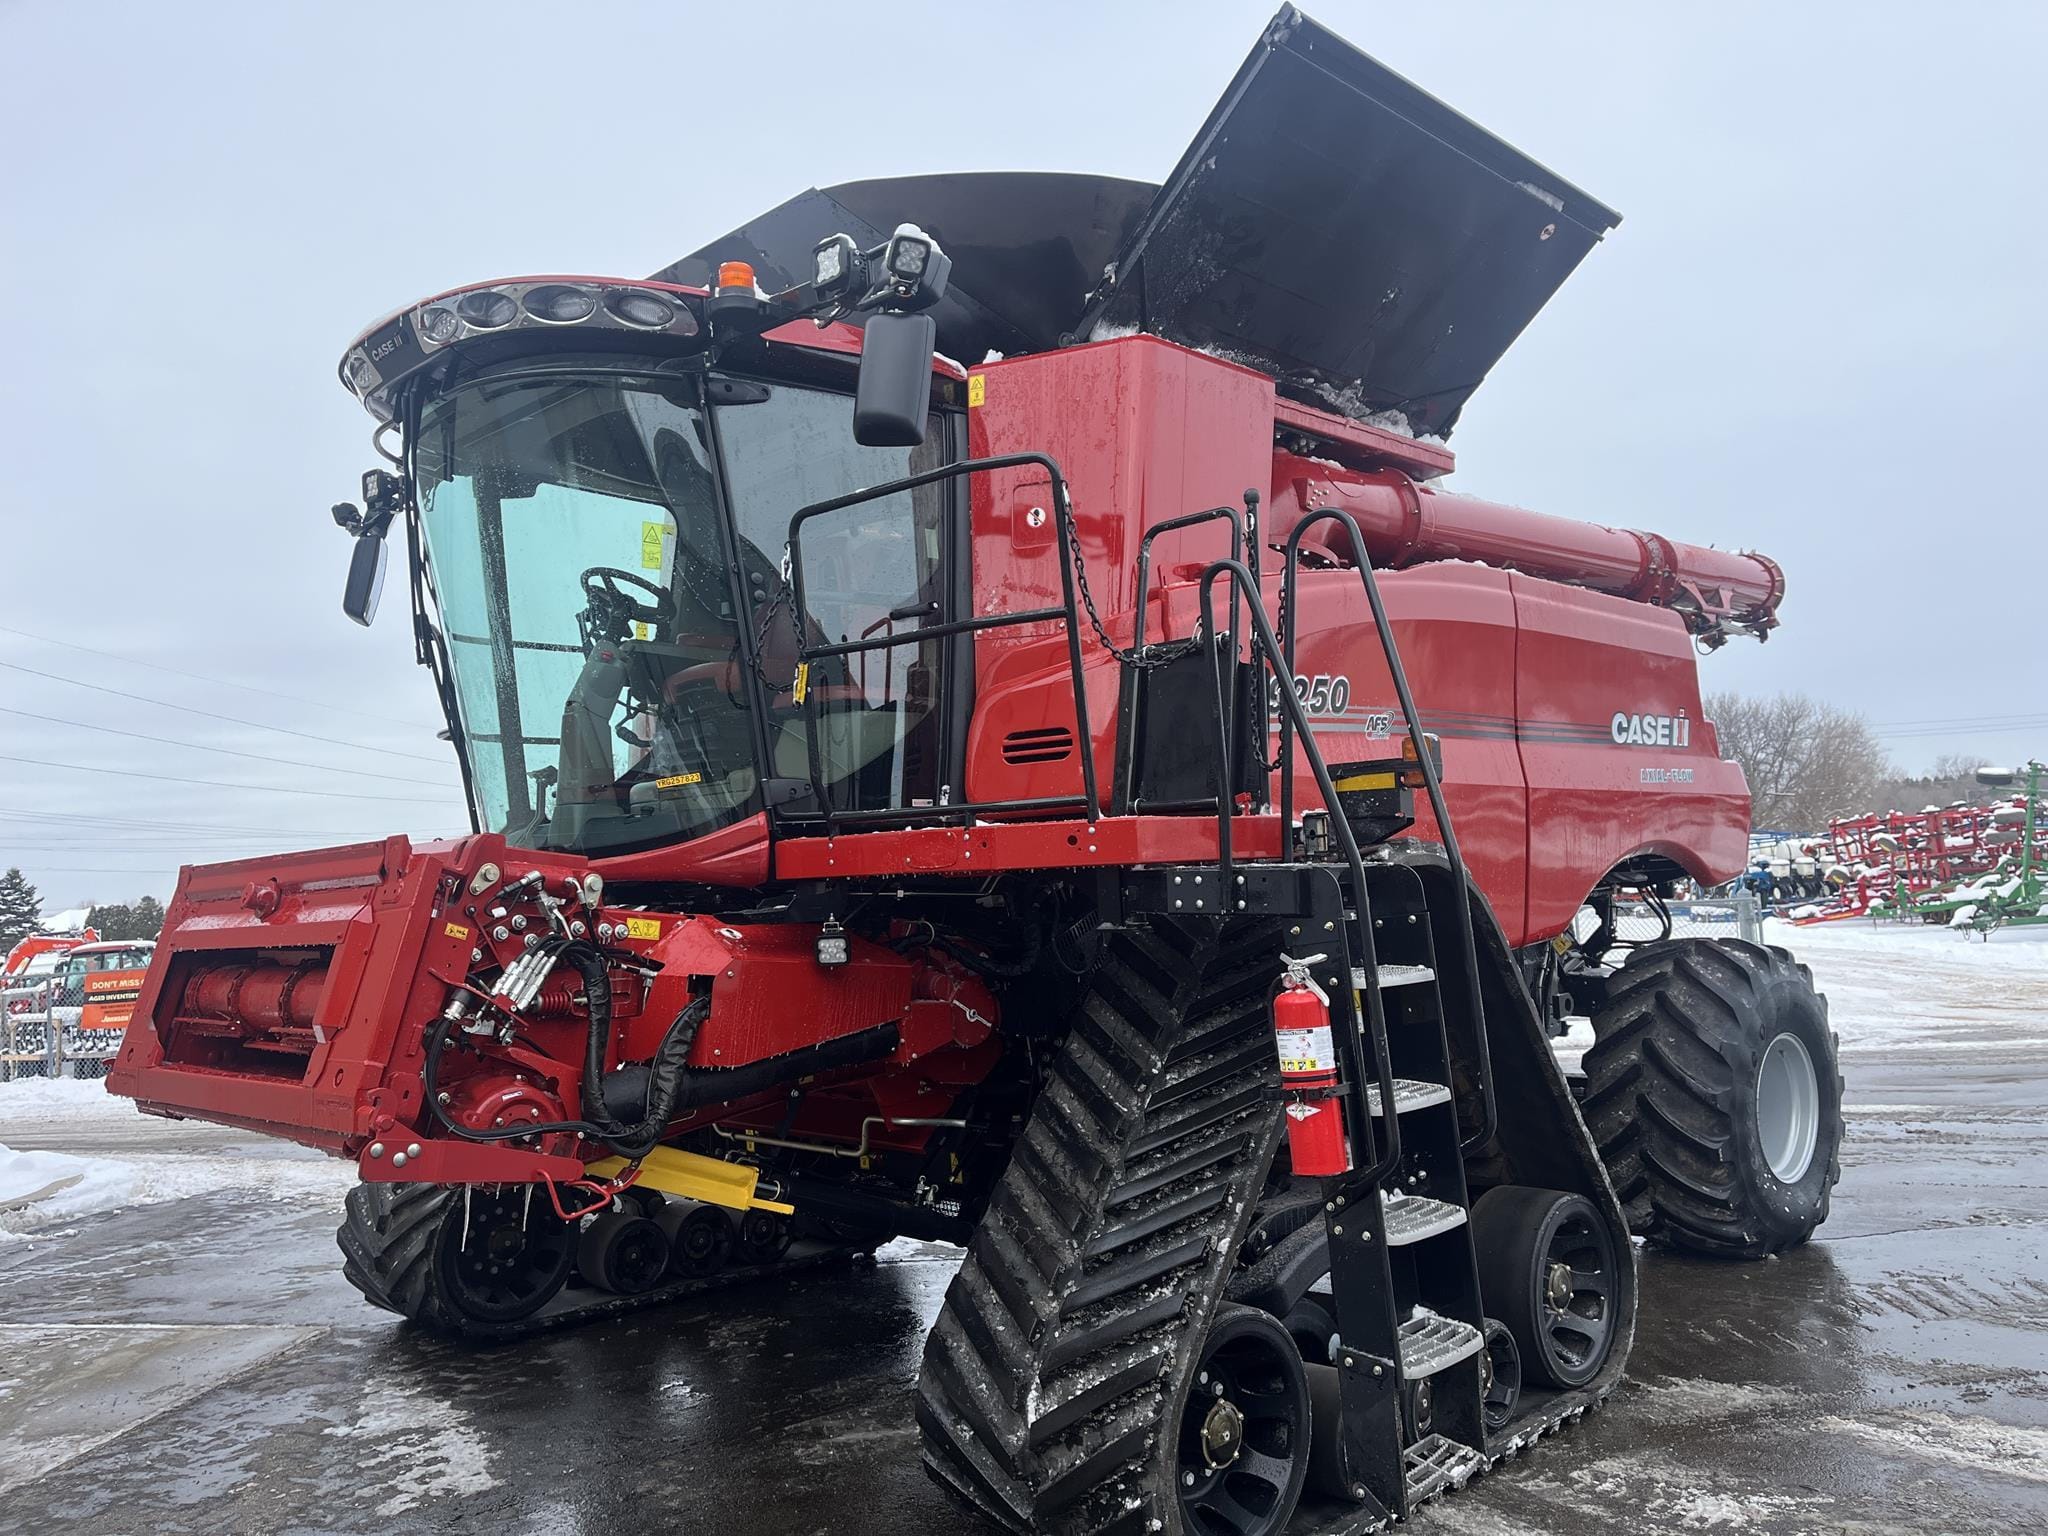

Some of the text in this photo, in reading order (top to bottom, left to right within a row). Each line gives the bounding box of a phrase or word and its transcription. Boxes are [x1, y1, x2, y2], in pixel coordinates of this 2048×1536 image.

[371, 339, 395, 361] CASE
[1366, 714, 1389, 732] AFS
[1611, 712, 1671, 746] CASE
[1640, 768, 1694, 784] AXIAL-FLOW
[91, 980, 118, 990] DON'T
[119, 978, 140, 988] MISS
